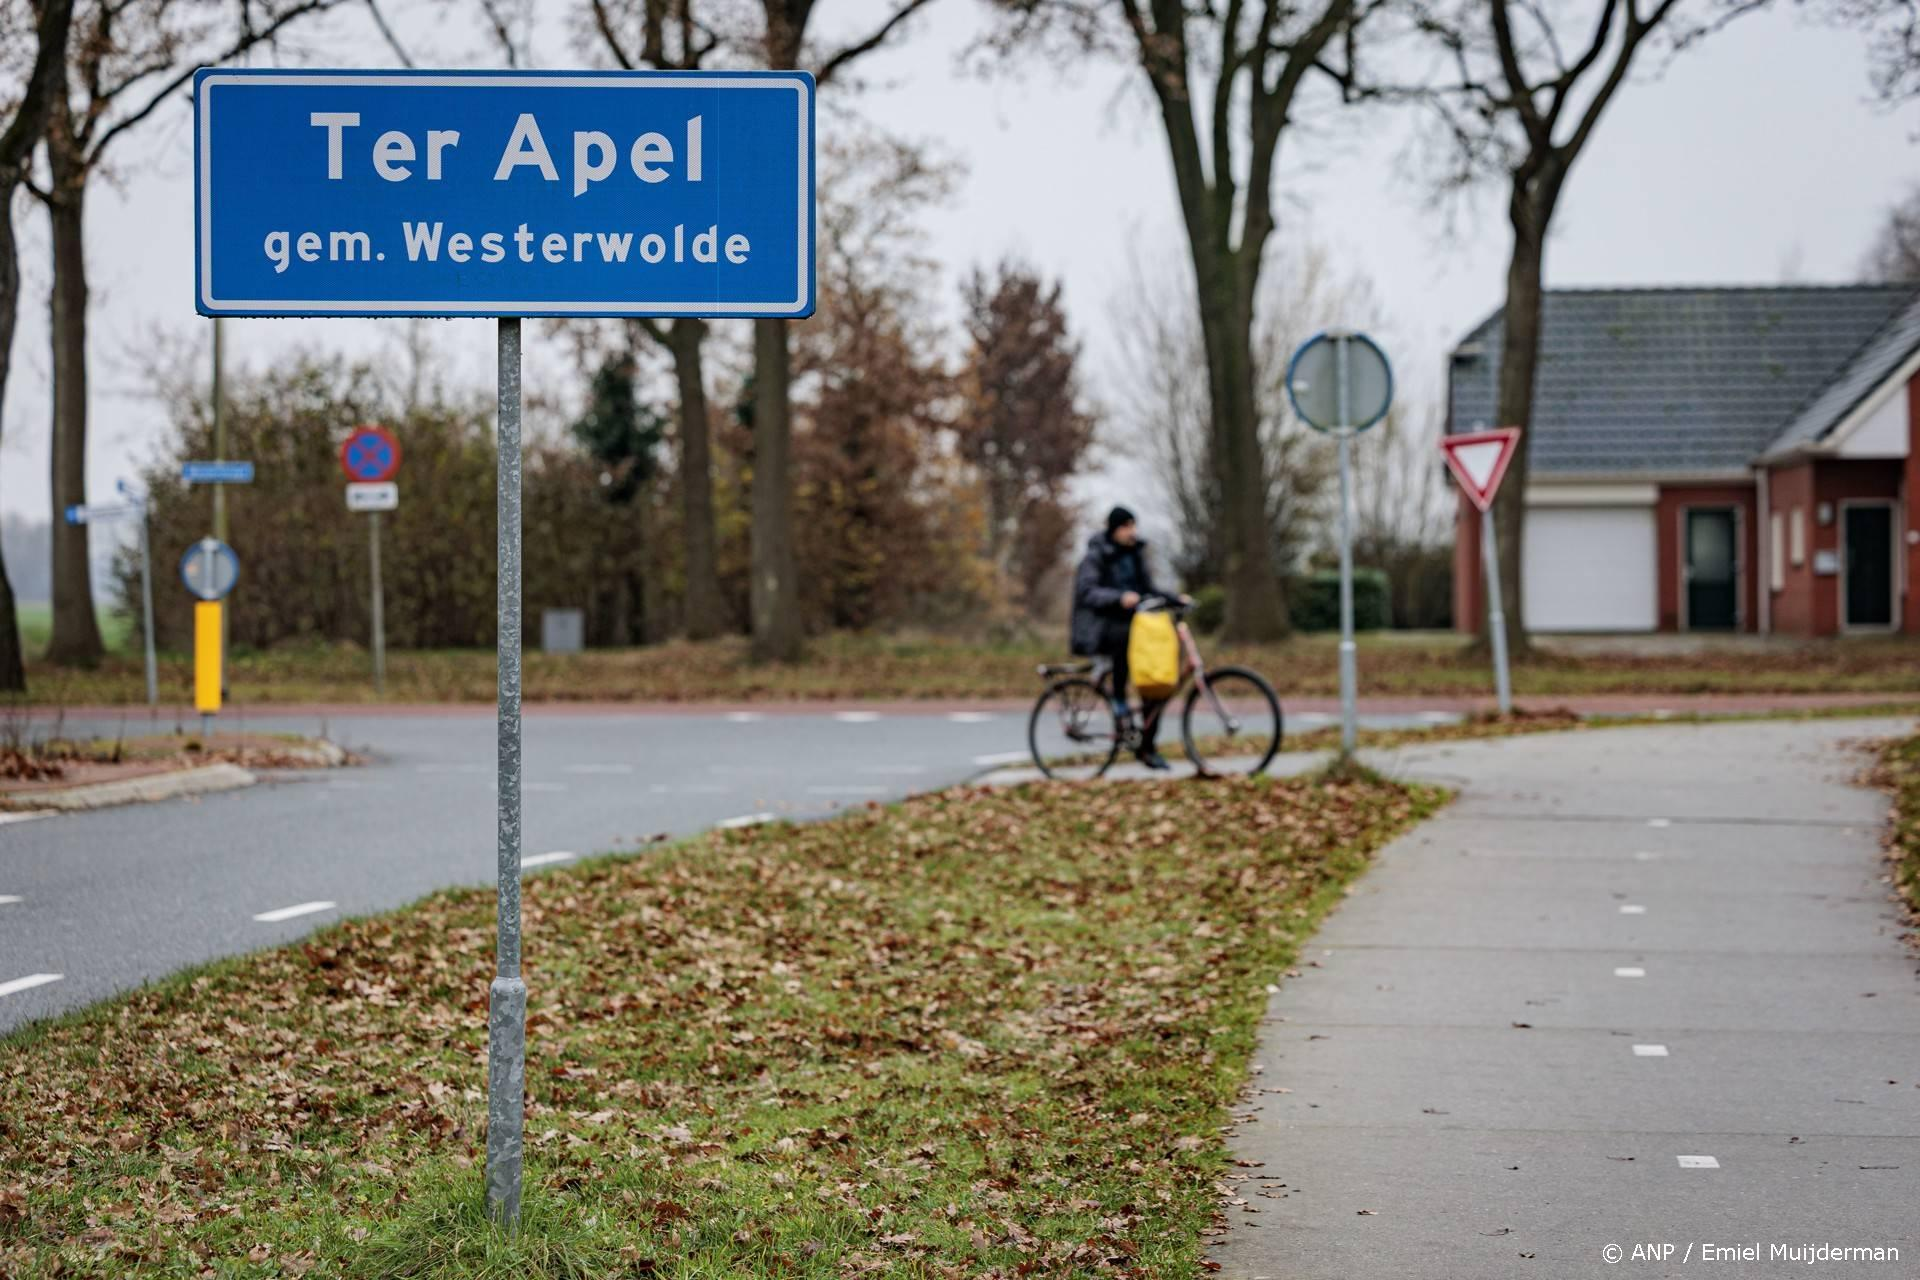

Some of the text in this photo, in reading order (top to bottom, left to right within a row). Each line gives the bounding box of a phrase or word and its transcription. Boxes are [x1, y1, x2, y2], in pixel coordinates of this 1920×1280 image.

[310, 112, 702, 197] Ter Apel
[264, 222, 750, 274] gem. Westerwolde
